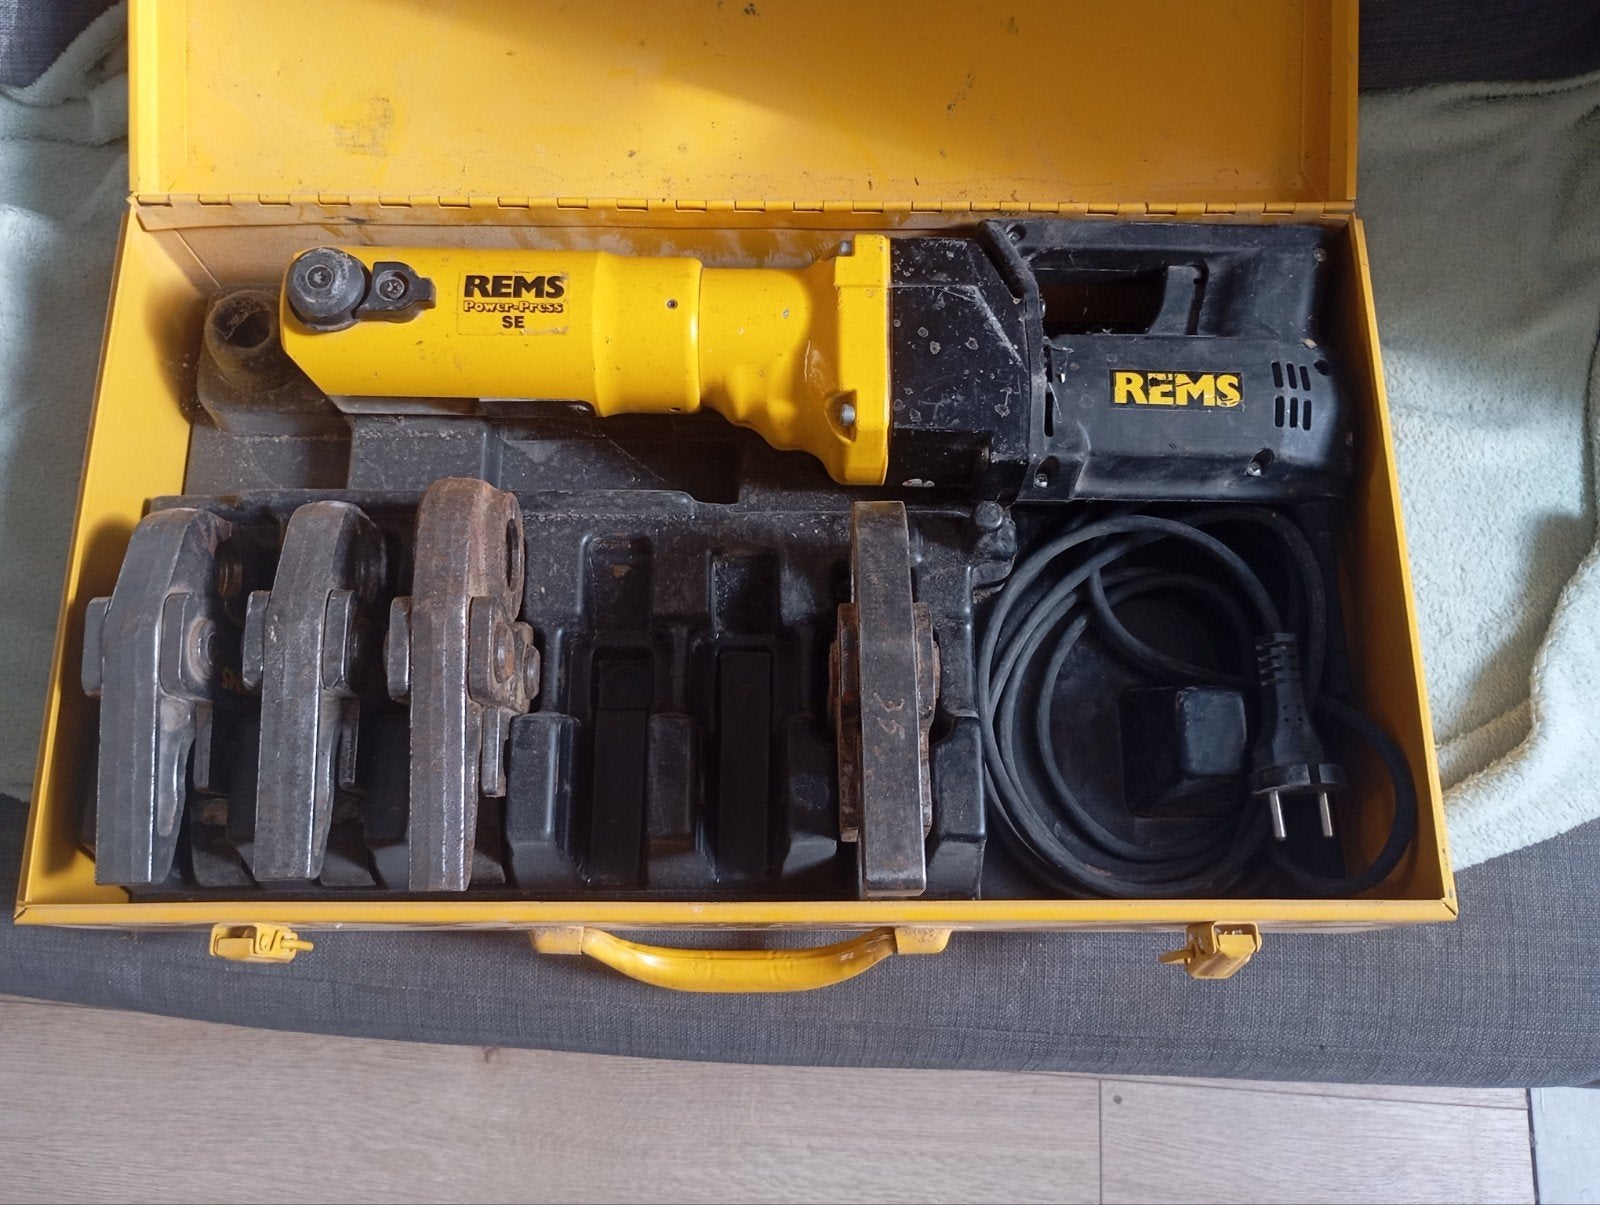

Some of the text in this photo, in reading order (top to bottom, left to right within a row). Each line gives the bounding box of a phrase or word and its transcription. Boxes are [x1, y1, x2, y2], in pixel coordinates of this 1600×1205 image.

[464, 275, 565, 298] REMS
[463, 300, 564, 313] Power-Press
[501, 315, 525, 329] SE
[1114, 371, 1241, 408] REMS
